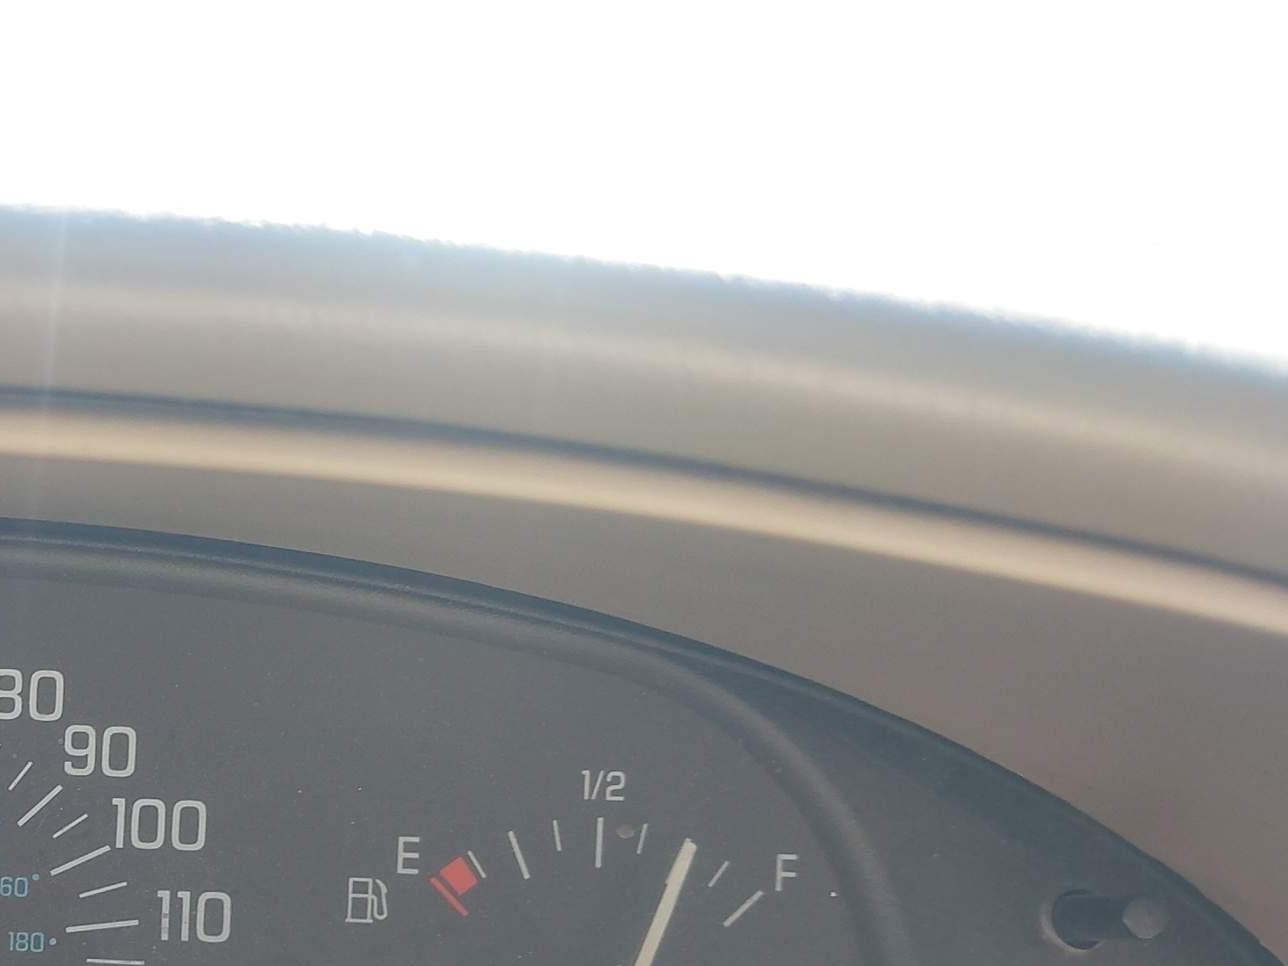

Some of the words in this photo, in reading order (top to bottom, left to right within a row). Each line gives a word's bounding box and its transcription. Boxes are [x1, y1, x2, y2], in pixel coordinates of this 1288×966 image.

[63, 726, 137, 777] 90
[580, 770, 626, 802] 1/2
[113, 798, 206, 851] 100
[397, 837, 420, 874] E
[776, 855, 798, 891] F
[157, 891, 232, 943] 110
[8, 931, 44, 952] 180
